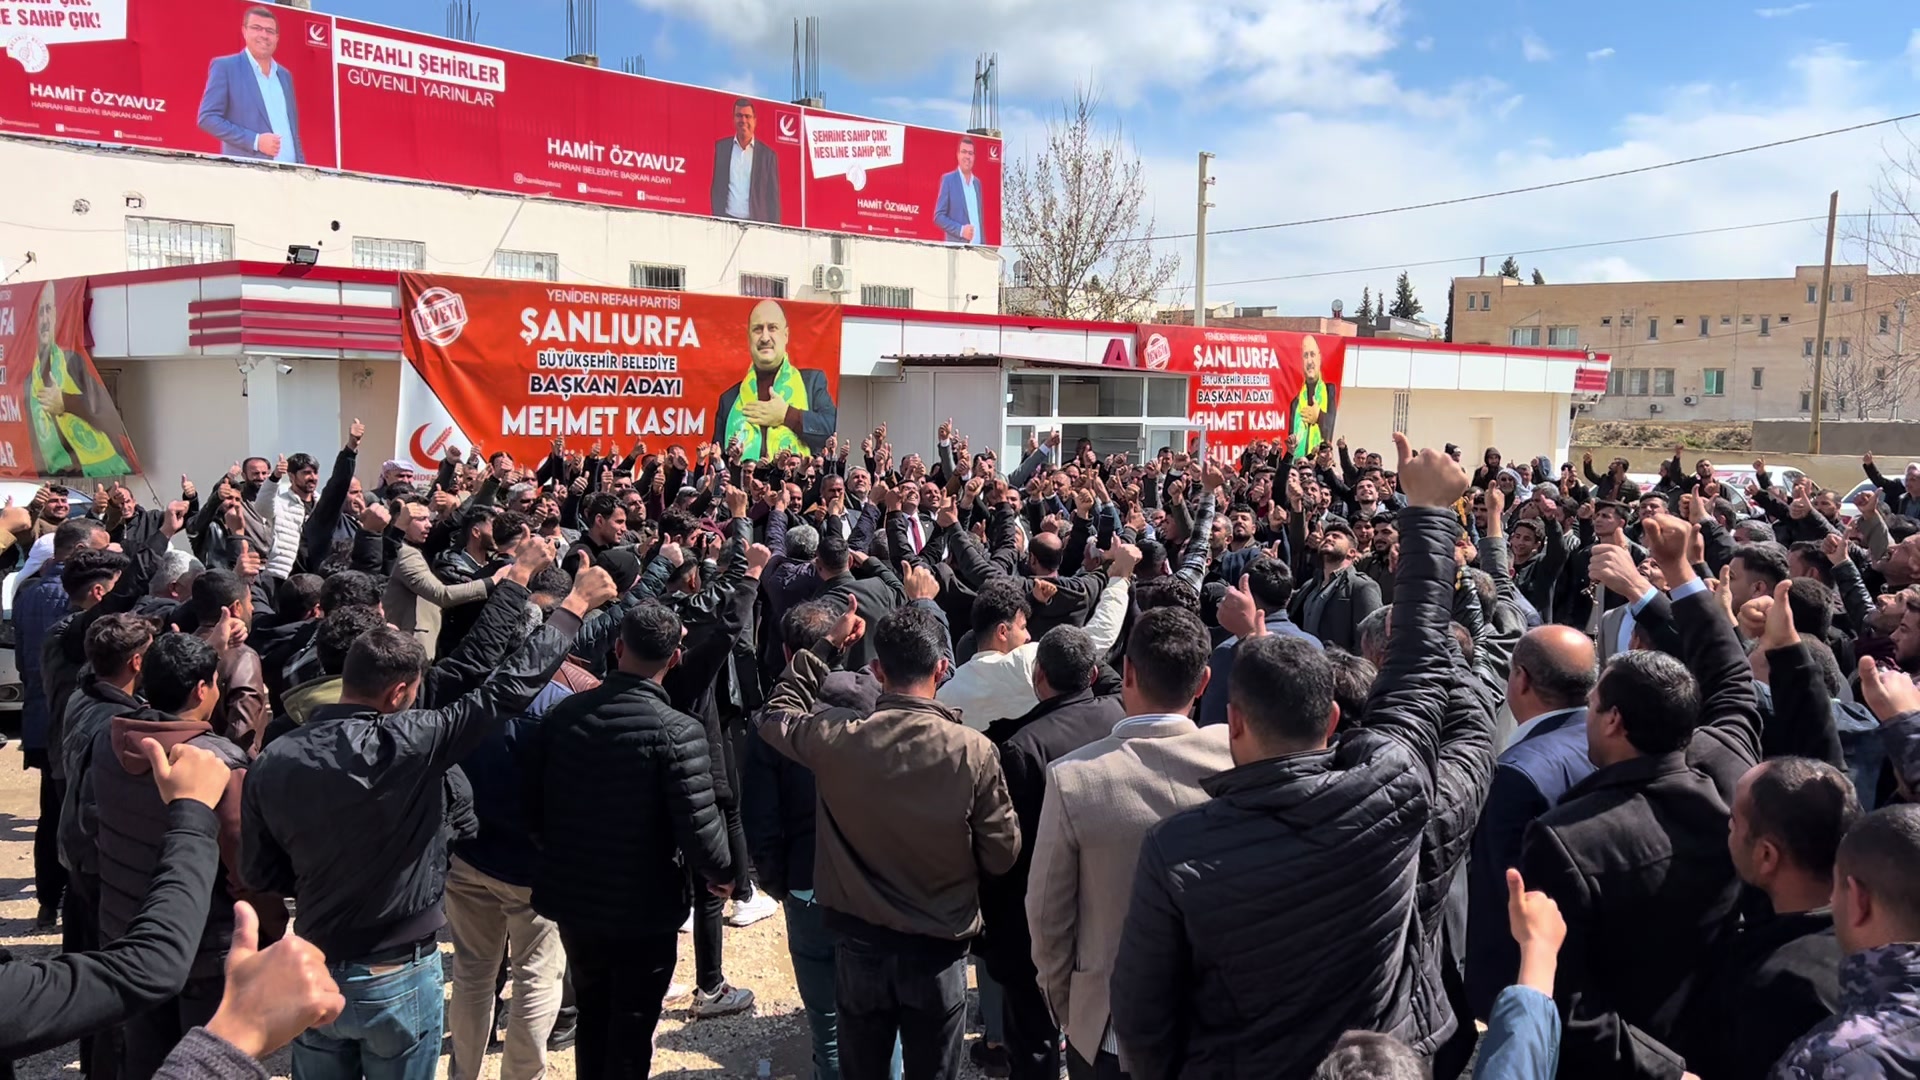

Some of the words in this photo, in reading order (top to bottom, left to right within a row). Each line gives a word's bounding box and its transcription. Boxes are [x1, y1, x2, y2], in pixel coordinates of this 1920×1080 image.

[68, 11, 101, 30] ÇIK!
[340, 38, 412, 68] REFAHLI
[419, 53, 500, 83] ŞEHİRLER
[29, 82, 86, 102] HAMİT
[91, 88, 166, 112] ÖZYAVUZ
[347, 68, 417, 94] GÜVENLİ
[420, 81, 495, 107] YARINLAR
[31, 101, 63, 111] HARRAN
[64, 104, 100, 115] BELEDİYE
[101, 109, 132, 119] BAŞKAN
[131, 113, 153, 121] ADAYI
[871, 129, 888, 143] ÇIK!
[547, 137, 605, 162] HAMİT
[609, 144, 686, 173] ÖZYAVUZ
[875, 145, 891, 159] ÇIK!
[547, 161, 582, 173] HARRAN
[583, 165, 619, 178] BELEDİYE
[620, 171, 650, 182] BAŞKAN
[650, 174, 672, 185] ADAYI
[857, 198, 882, 210] HAMİT
[884, 199, 919, 214] ÖZYAVUZ
[546, 287, 599, 304] YENİDEN
[602, 292, 638, 307] REFAH
[640, 294, 681, 309] PARTİSİ
[520, 307, 701, 348] ŞANLIURFA
[539, 350, 618, 372] BÜYÜKŞEHİR
[622, 352, 676, 370] BELEDİYE
[1102, 338, 1130, 367] A
[1193, 344, 1280, 371] ŞANLIURFA
[530, 376, 617, 399] BAŞKAN
[623, 378, 681, 395] ADAYI
[1198, 390, 1241, 406] BAŞKAN
[1245, 391, 1273, 402] ADAYI
[501, 405, 619, 435] MEHMET
[626, 406, 706, 436] KASIM
[1248, 411, 1285, 430] KASIM
